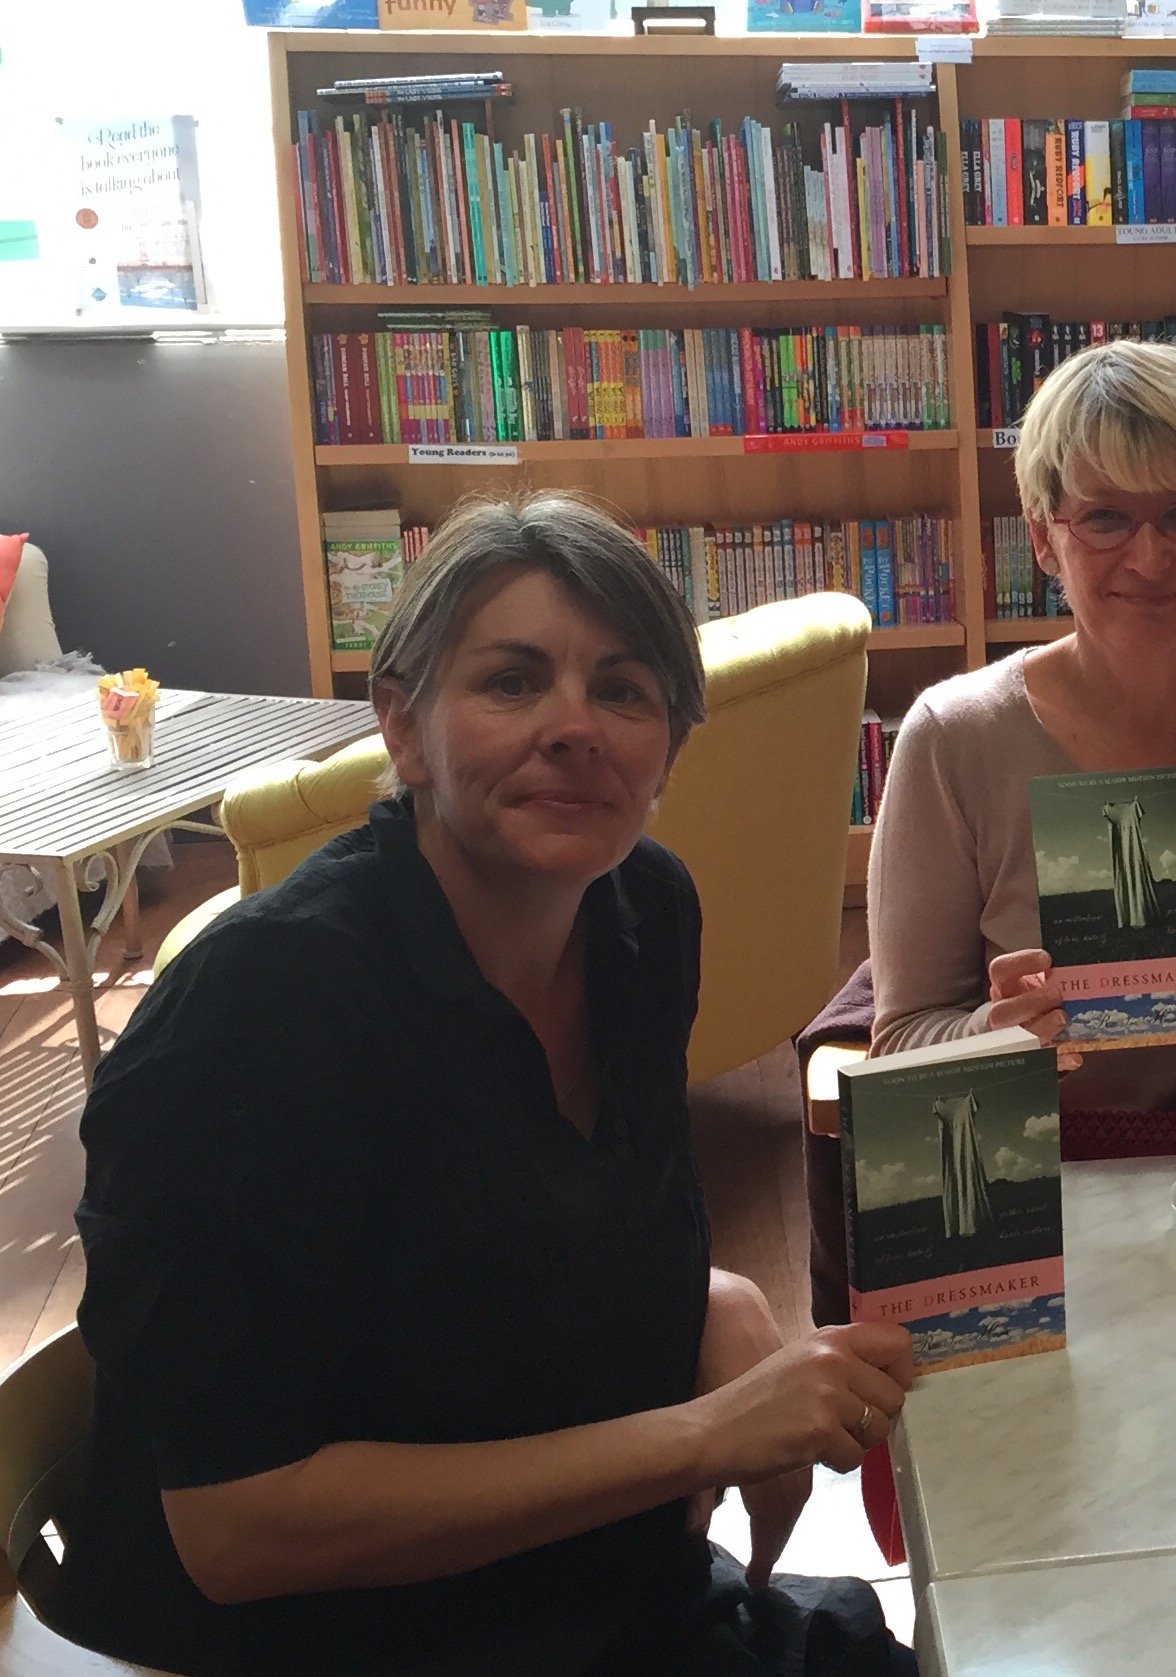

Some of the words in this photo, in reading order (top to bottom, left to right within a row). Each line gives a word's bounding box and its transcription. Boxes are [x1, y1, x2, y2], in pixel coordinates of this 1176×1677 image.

[139, 121, 160, 138] the
[1055, 137, 1063, 163] RUBY
[1071, 130, 1080, 157] RUBY
[80, 151, 113, 172] book
[116, 144, 181, 167] everyone
[81, 180, 93, 196] is
[95, 174, 143, 196] talking
[143, 167, 182, 185] about
[412, 447, 444, 457] Young
[446, 448, 486, 456] Readers
[1060, 979, 1091, 993] THE
[879, 1299, 913, 1317] THE
[923, 1275, 1041, 1307] DRESSMAKER
